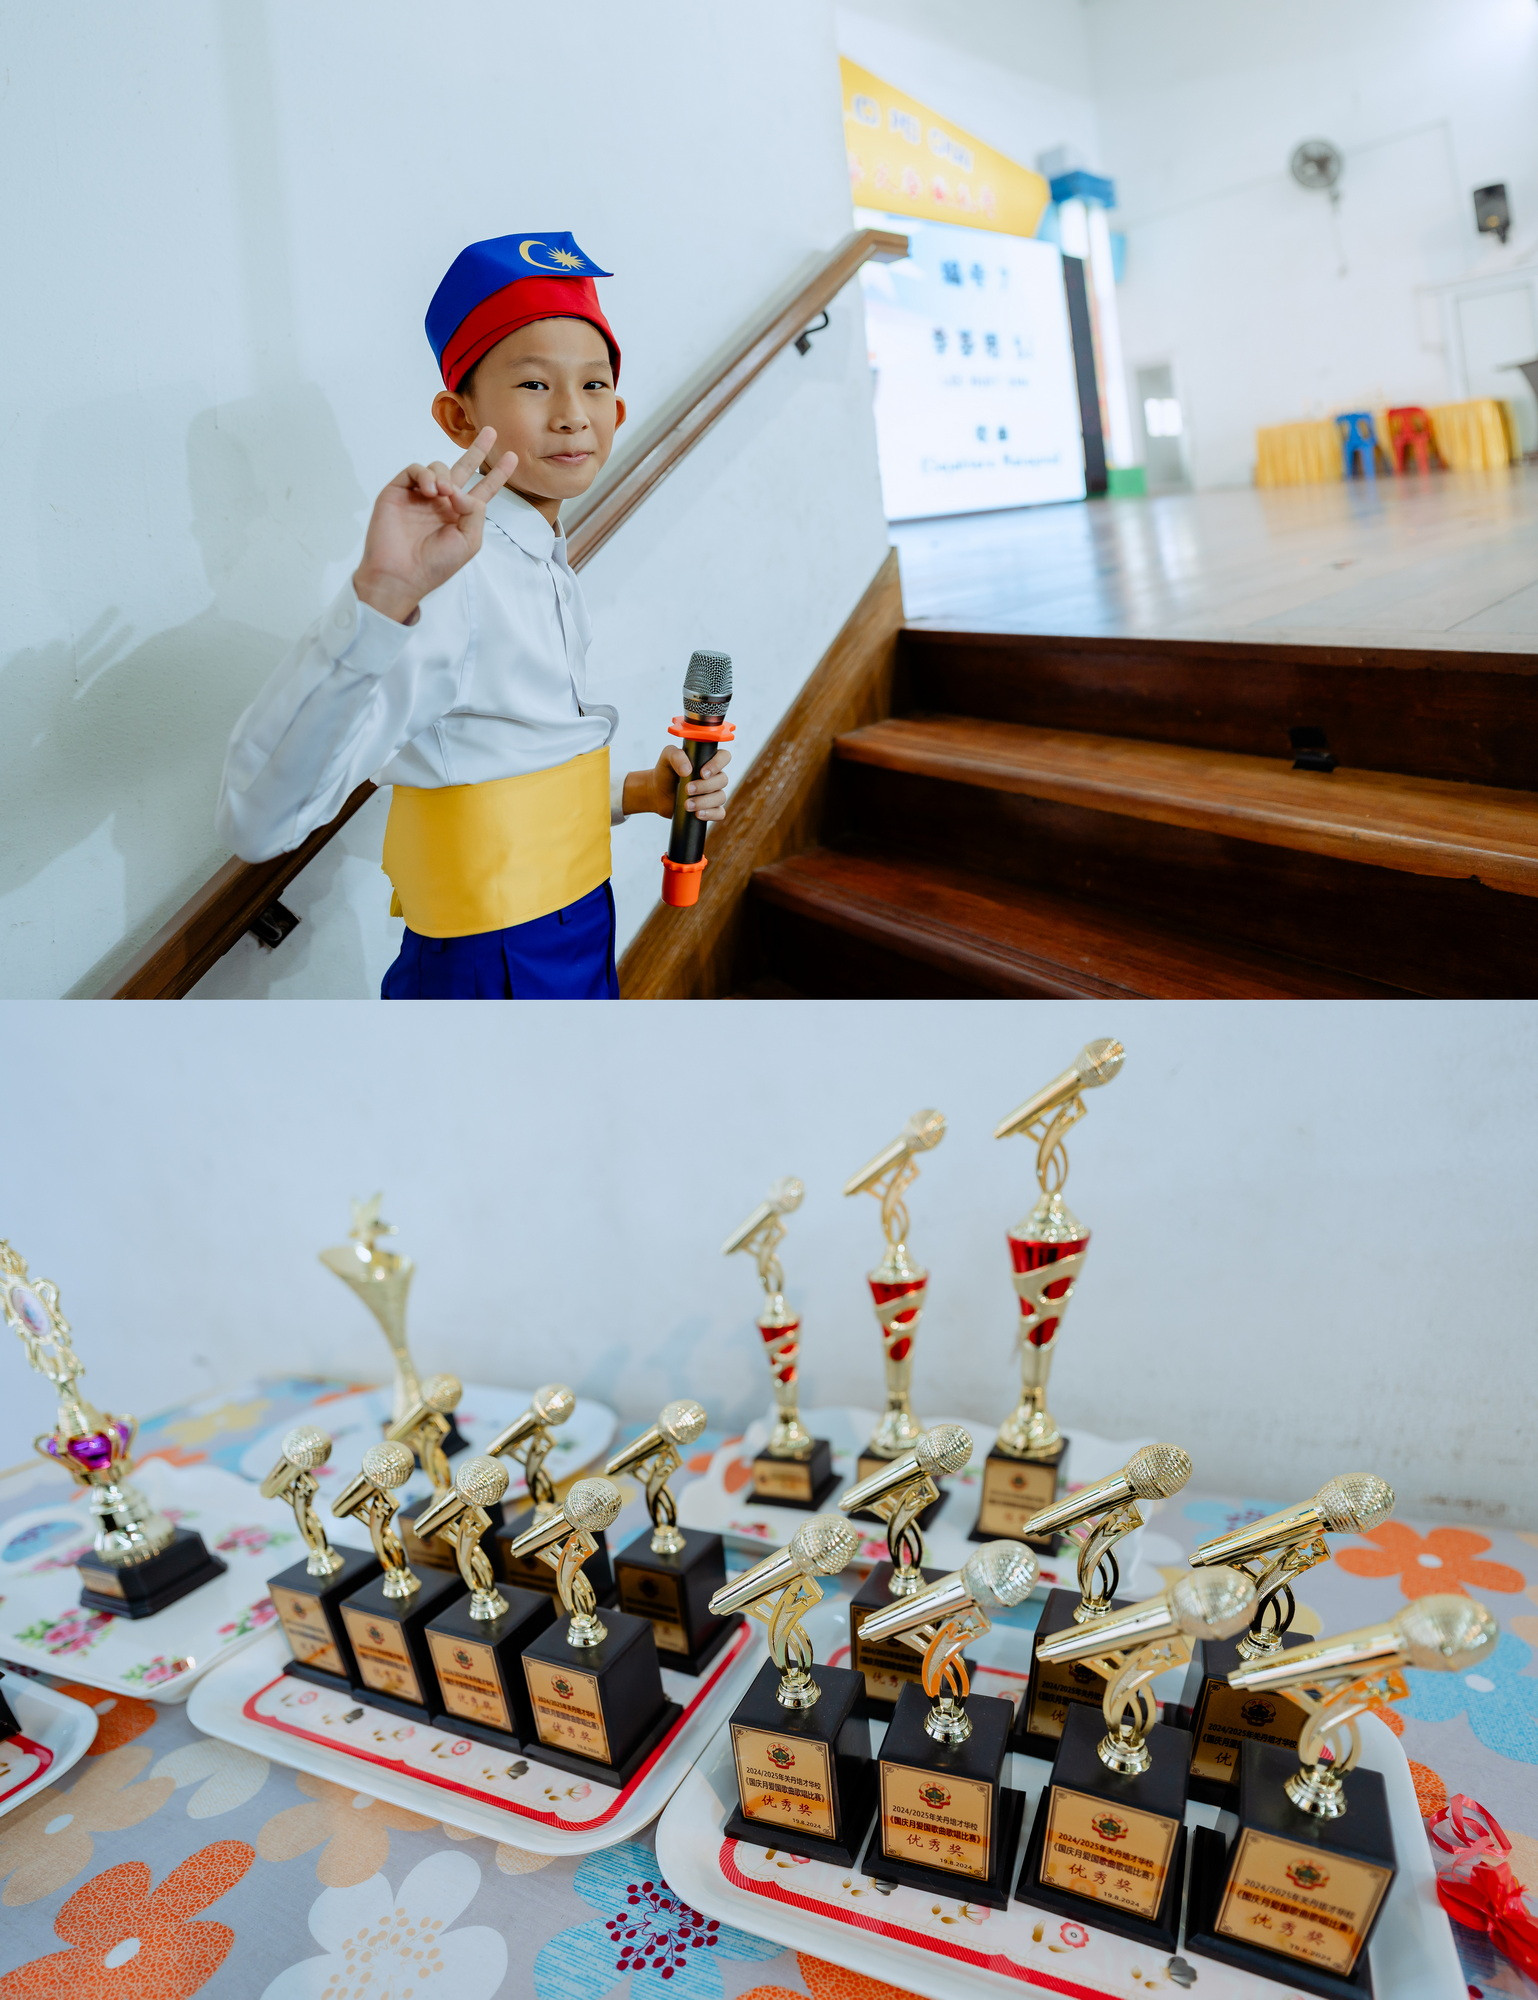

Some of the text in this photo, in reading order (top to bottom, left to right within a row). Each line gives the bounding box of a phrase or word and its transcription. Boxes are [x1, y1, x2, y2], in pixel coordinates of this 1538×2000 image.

[761, 1794, 813, 1817] 优秀奖
[906, 1833, 965, 1858] 优秀奖
[939, 1858, 973, 1870] 19.8.2024
[1067, 1862, 1133, 1893] 优秀奖
[1102, 1891, 1140, 1908] 19.8.2024
